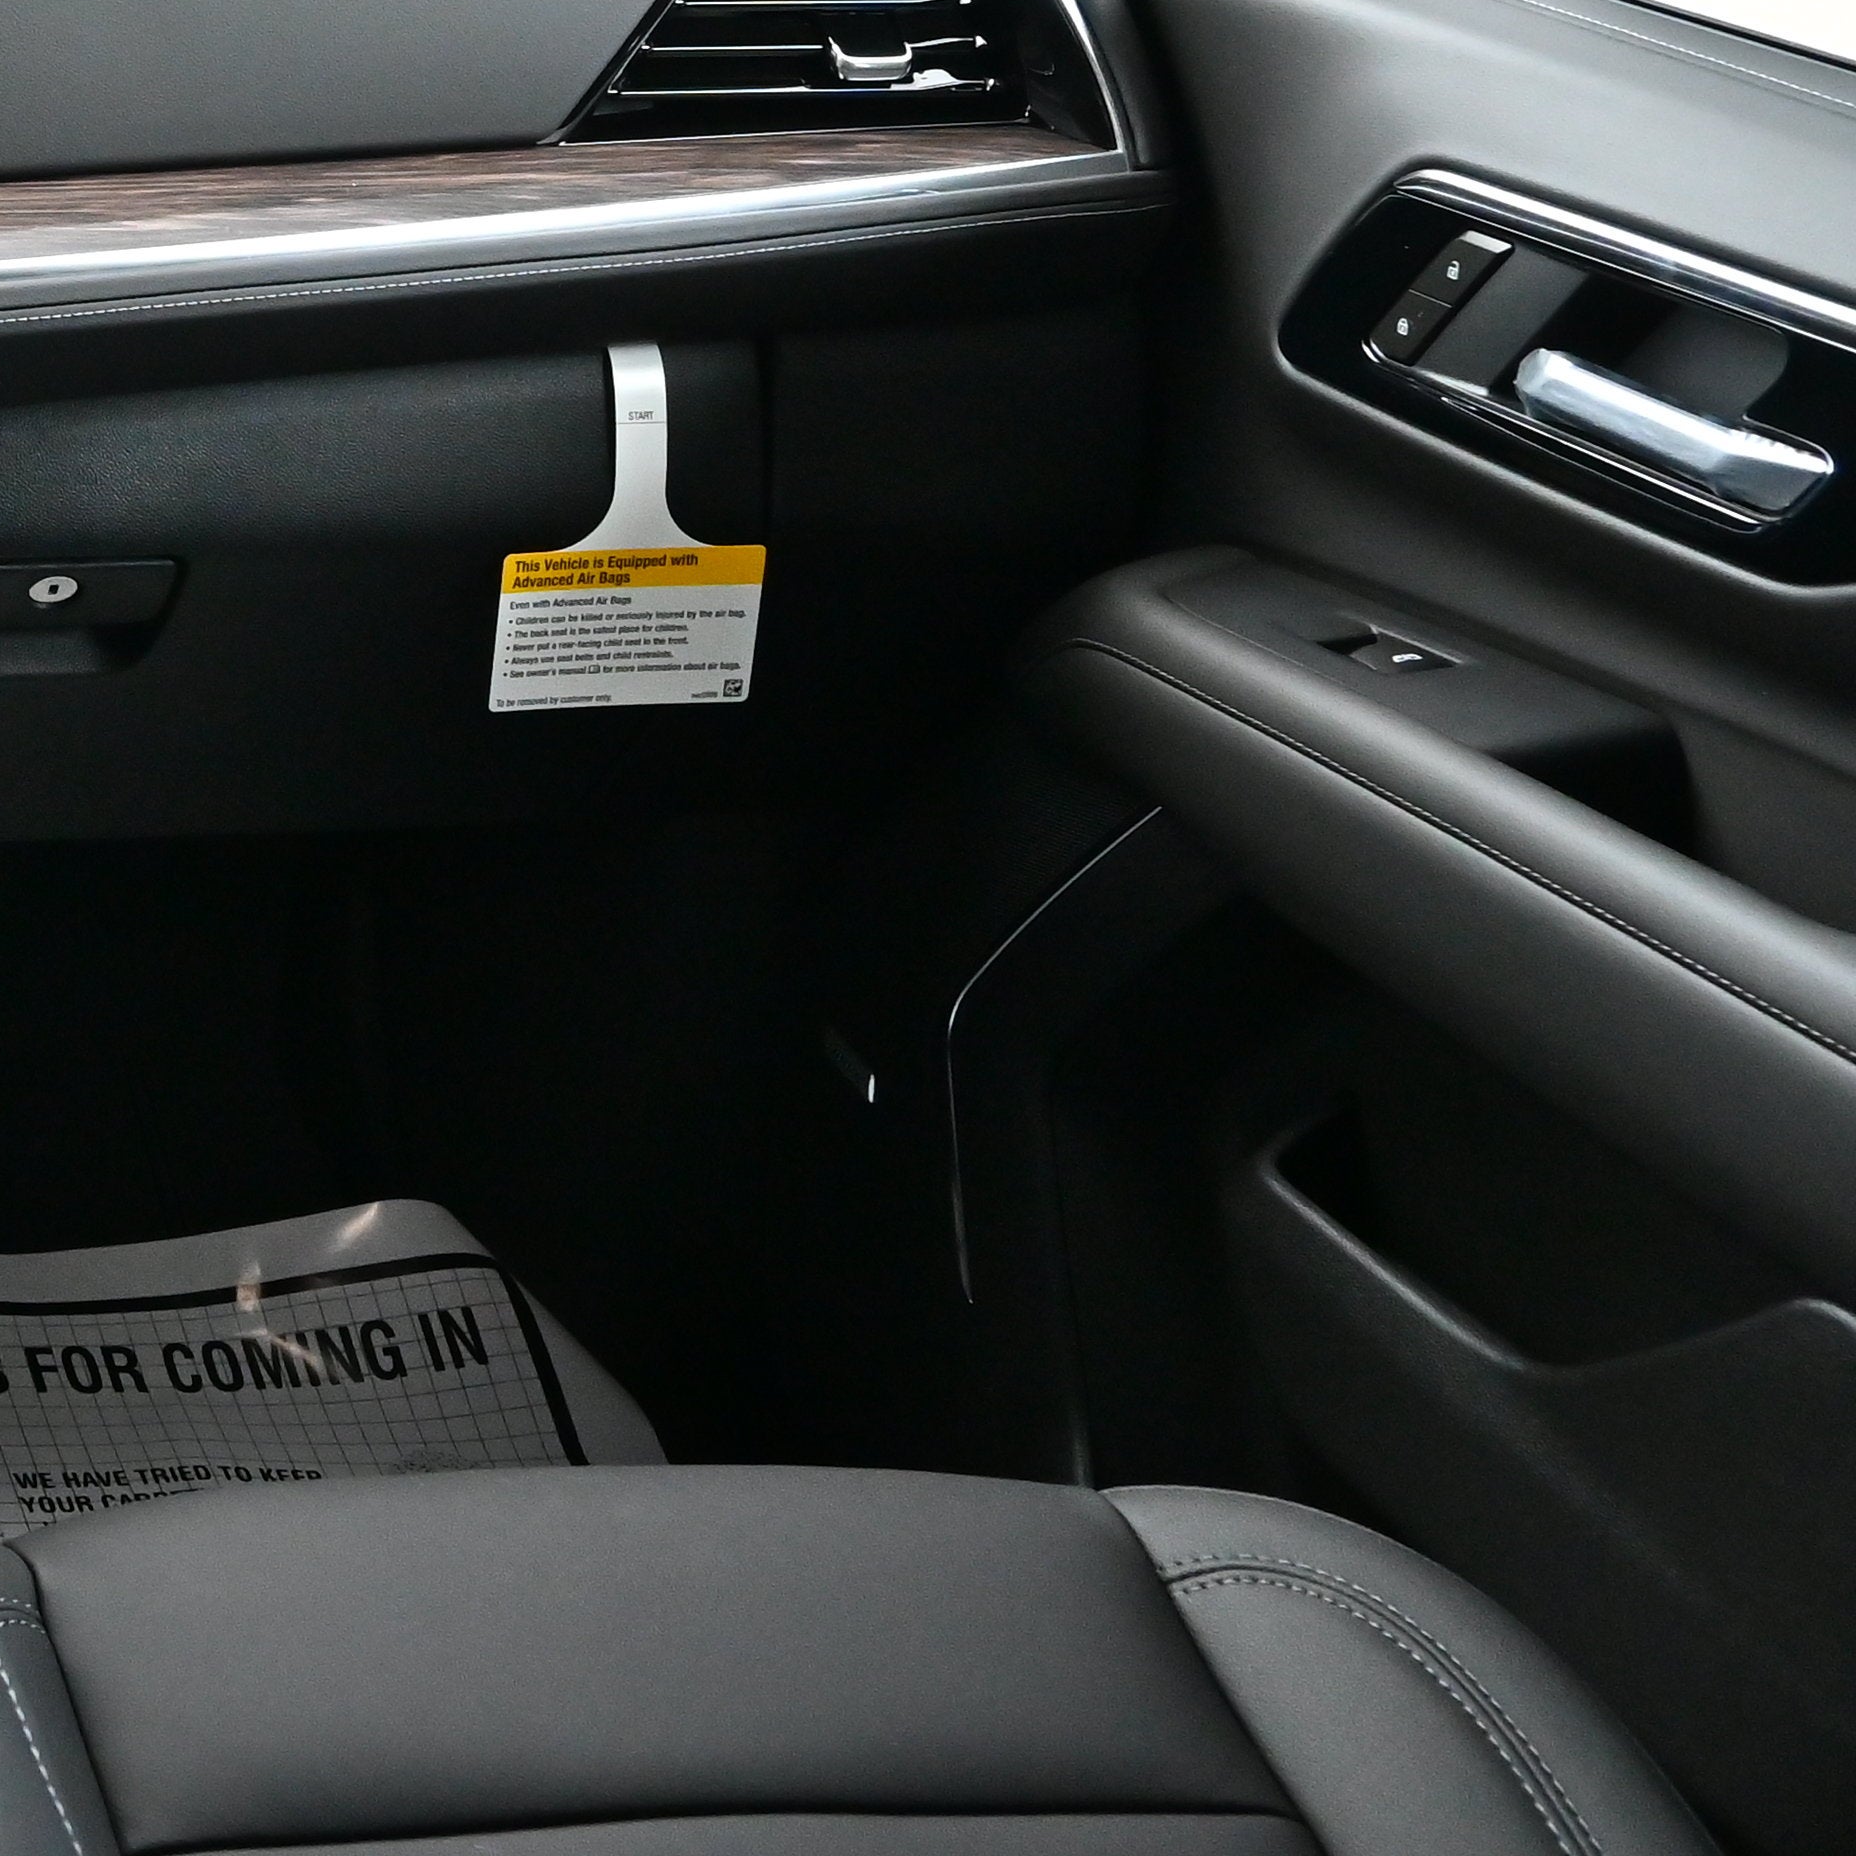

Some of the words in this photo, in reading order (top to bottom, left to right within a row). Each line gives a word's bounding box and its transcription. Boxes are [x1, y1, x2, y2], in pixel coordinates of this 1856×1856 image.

[628, 410, 654, 421] START
[515, 558, 540, 573] This
[545, 556, 589, 571] Vehicle
[593, 556, 604, 569] is
[608, 554, 667, 572] Equipped
[671, 553, 698, 566] with
[512, 574, 574, 589] Advanced
[577, 573, 595, 585] Air
[599, 572, 631, 586] Bags
[510, 601, 530, 610] Even
[532, 599, 550, 608] with
[552, 597, 594, 607] Advanced
[596, 596, 608, 606] Air
[610, 595, 632, 606] Bags
[516, 616, 549, 626] Children
[568, 614, 578, 622] be
[581, 613, 603, 621] killed
[687, 610, 697, 619] by
[699, 610, 713, 618] the
[515, 630, 528, 639] The
[530, 629, 548, 637] back
[578, 626, 590, 635] the
[618, 625, 640, 634] place
[642, 624, 653, 632] for
[537, 642, 550, 652] put
[603, 639, 623, 647] child
[653, 637, 666, 645] the
[510, 670, 524, 678] See
[708, 662, 719, 670] air
[506, 698, 515, 707] be
[549, 696, 558, 705] by
[23, 1344, 148, 1395] FOR
[162, 1318, 408, 1394] COMING
[418, 1306, 491, 1372] IN
[12, 1471, 56, 1490] WE
[61, 1469, 130, 1489] HAVE
[133, 1464, 213, 1485] TRIED
[217, 1464, 252, 1483] TO
[19, 1495, 95, 1514] YOUR
